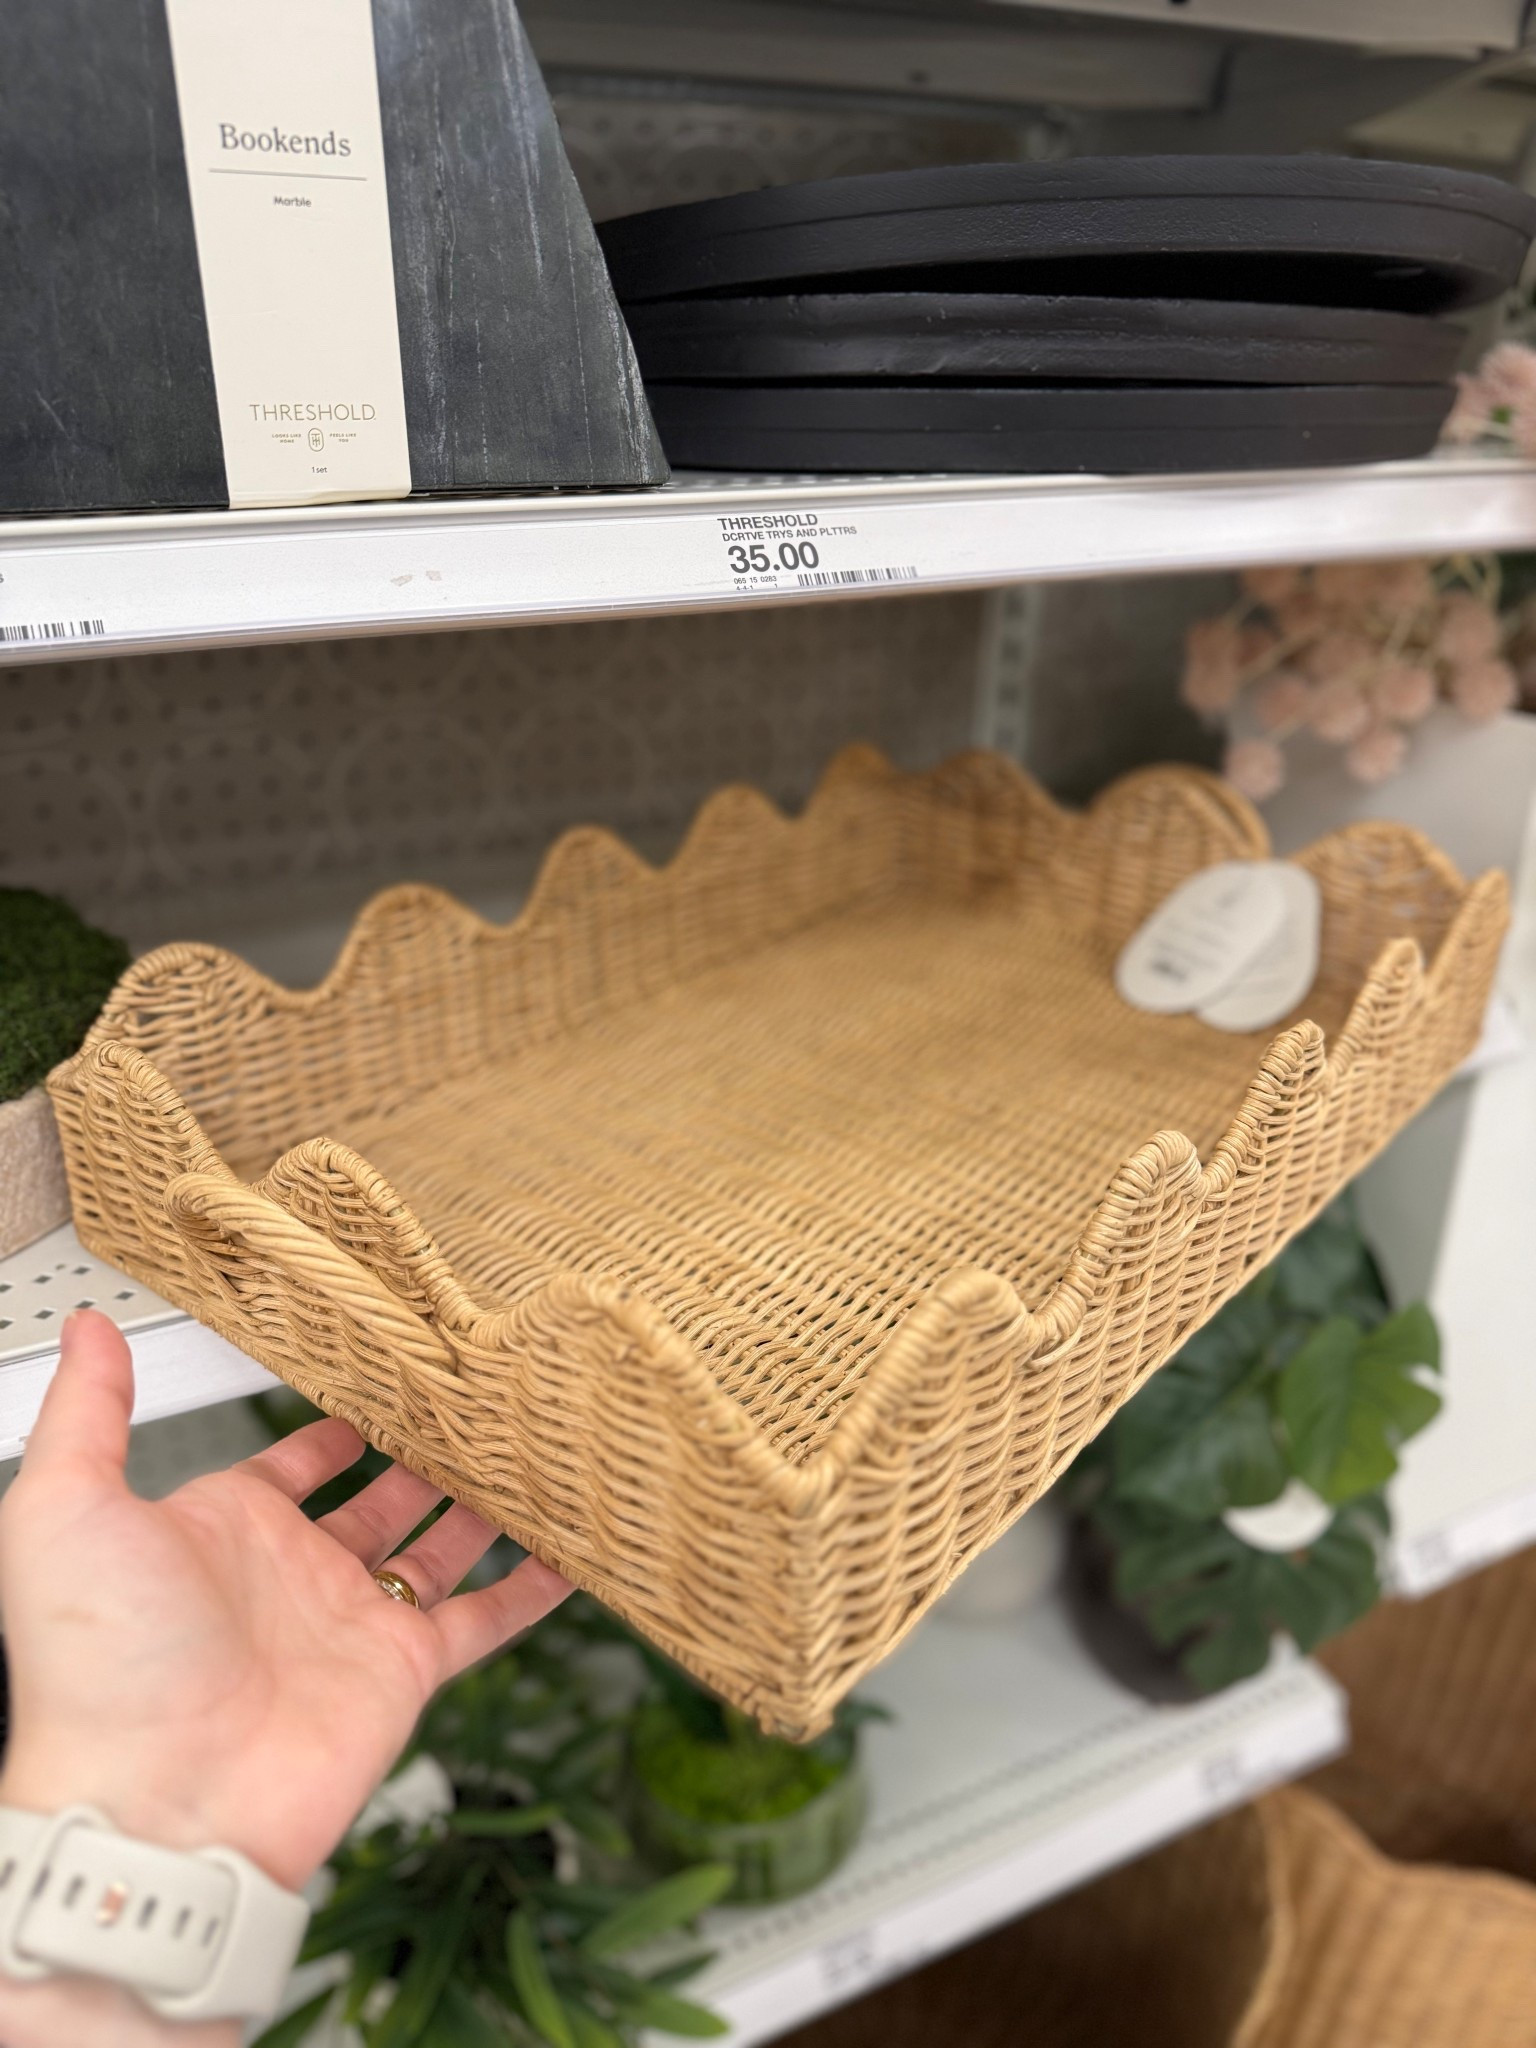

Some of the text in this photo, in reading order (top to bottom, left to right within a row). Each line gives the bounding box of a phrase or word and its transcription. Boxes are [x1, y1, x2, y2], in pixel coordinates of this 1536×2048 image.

[219, 122, 352, 157] Bookends
[273, 196, 312, 208] Marble
[249, 403, 376, 421] THRESHOLD
[717, 513, 818, 531] THRESHOLD
[722, 526, 858, 542] DCRTVE TRYS AND PLTTRS
[728, 541, 819, 574] 35.00
